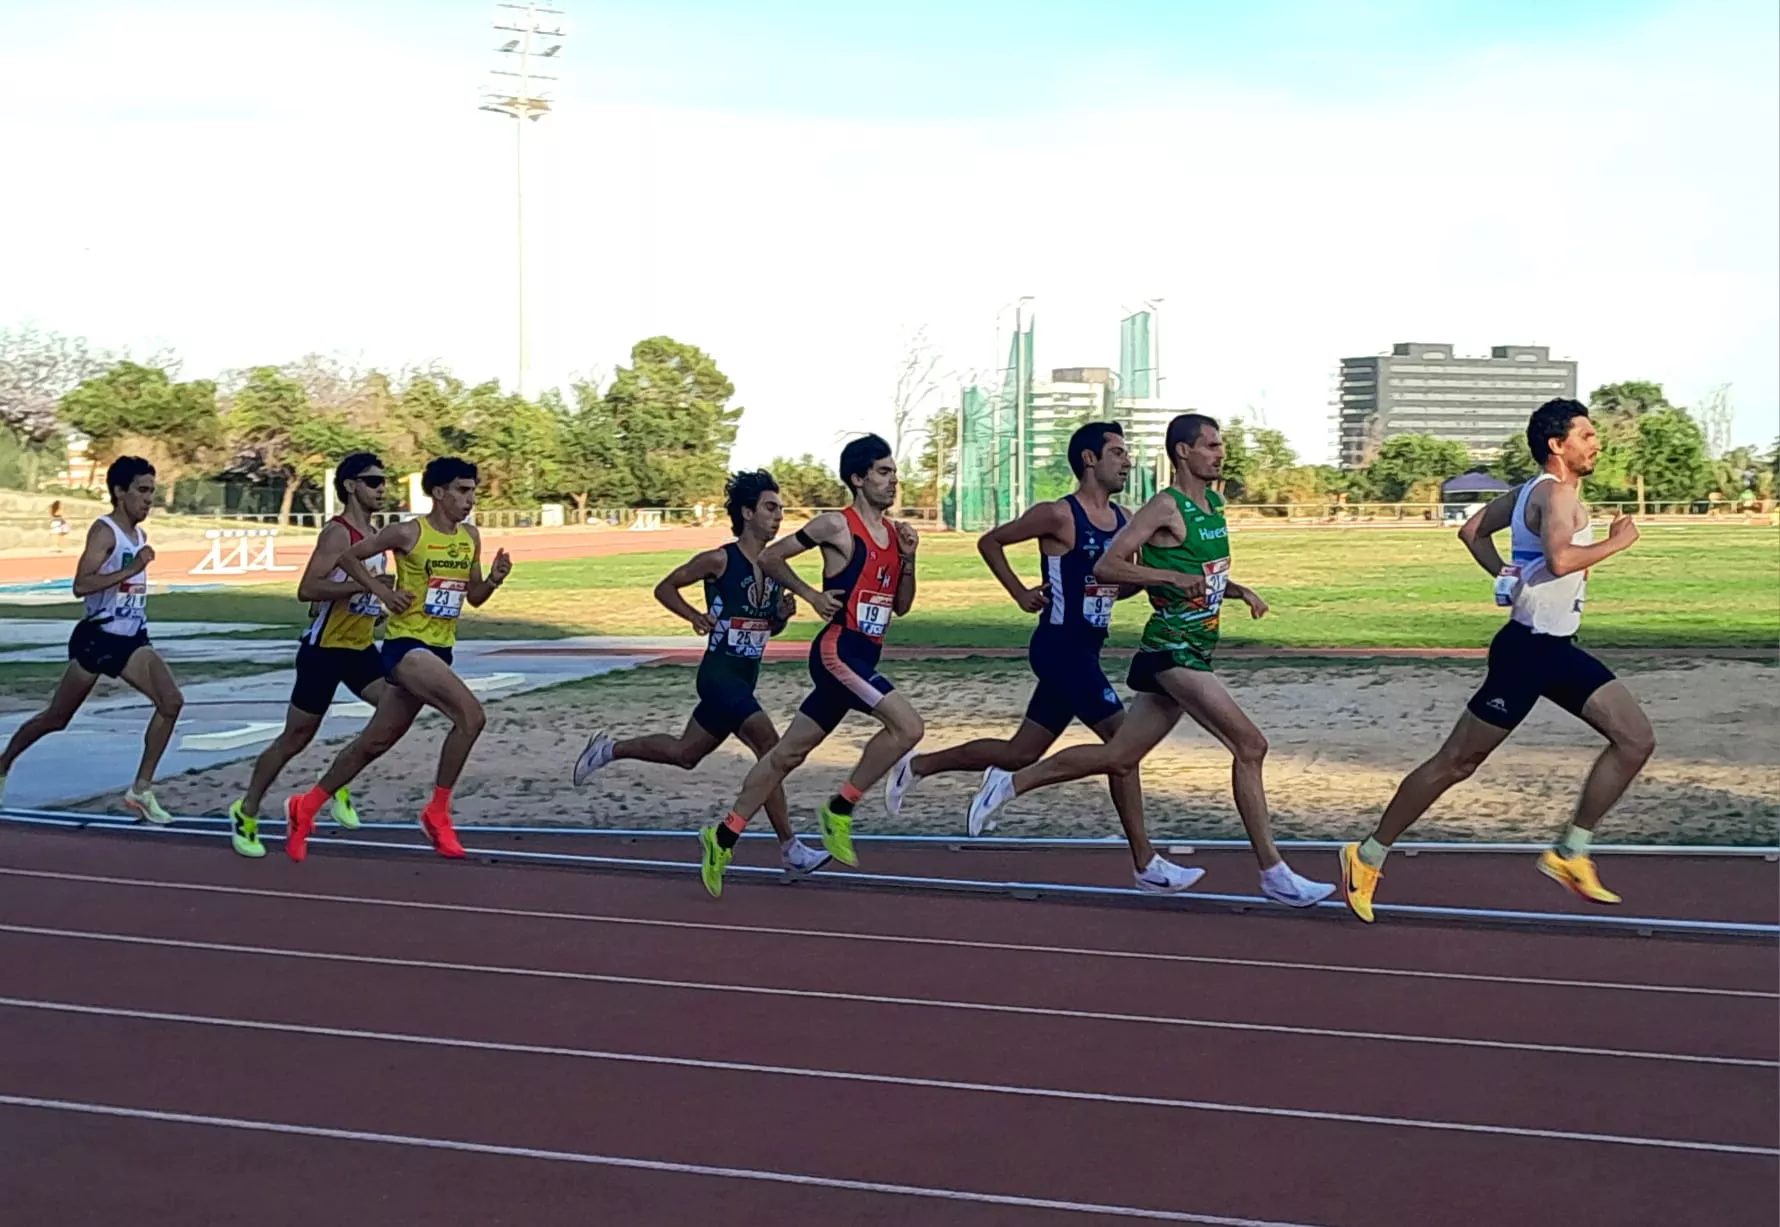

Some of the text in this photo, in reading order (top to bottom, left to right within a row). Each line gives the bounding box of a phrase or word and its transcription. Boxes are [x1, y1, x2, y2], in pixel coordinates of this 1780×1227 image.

[435, 590, 450, 605] 23
[865, 605, 880, 621] 19
[1095, 598, 1102, 613] 9
[736, 631, 751, 645] 25
